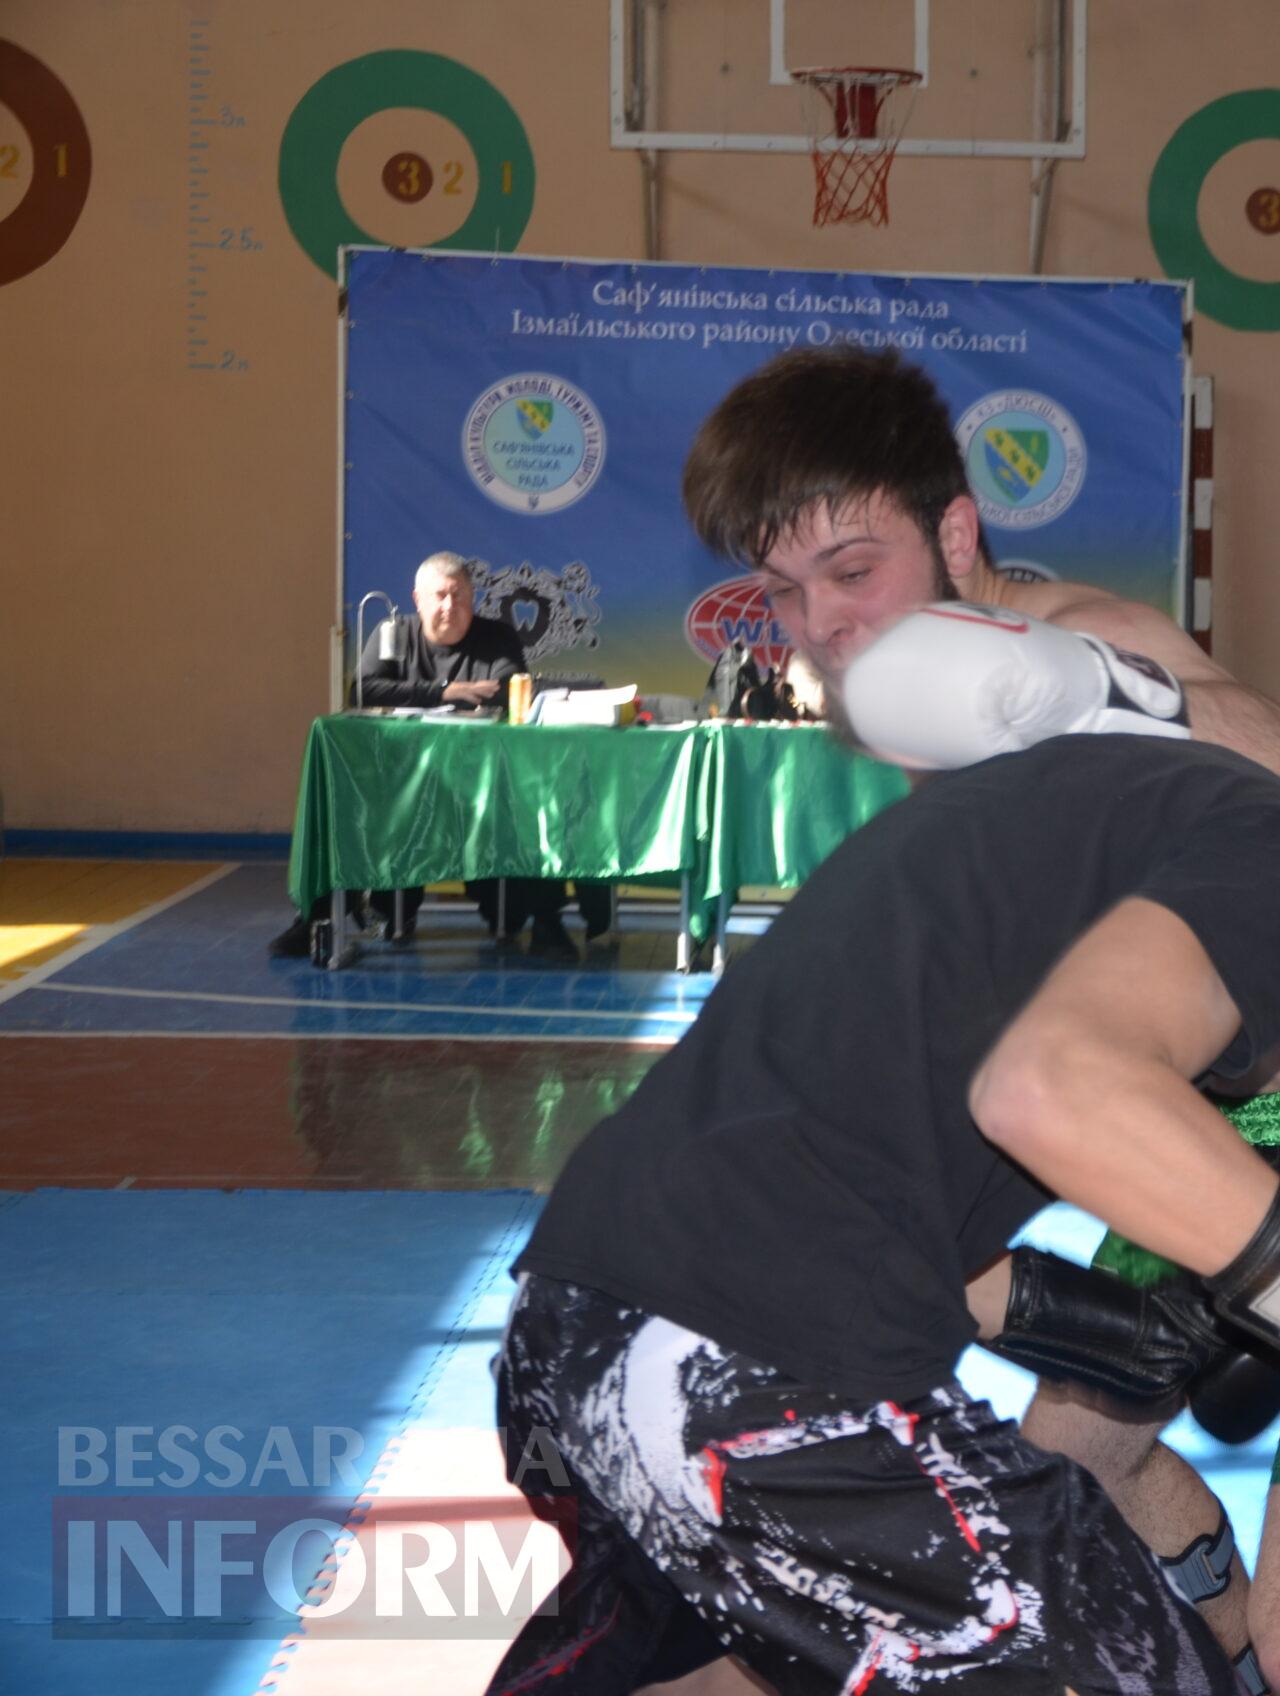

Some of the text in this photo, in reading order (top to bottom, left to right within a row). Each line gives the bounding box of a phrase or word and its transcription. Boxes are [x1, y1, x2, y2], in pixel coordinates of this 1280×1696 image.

[53, 143, 68, 177] 1
[397, 159, 512, 195] 3 2 1
[1258, 192, 1280, 229] 3
[775, 288, 882, 315] сільська
[889, 298, 949, 323] рада
[511, 308, 1028, 354] Ізмаїльського району Одеської області
[518, 474, 549, 488] РАДА
